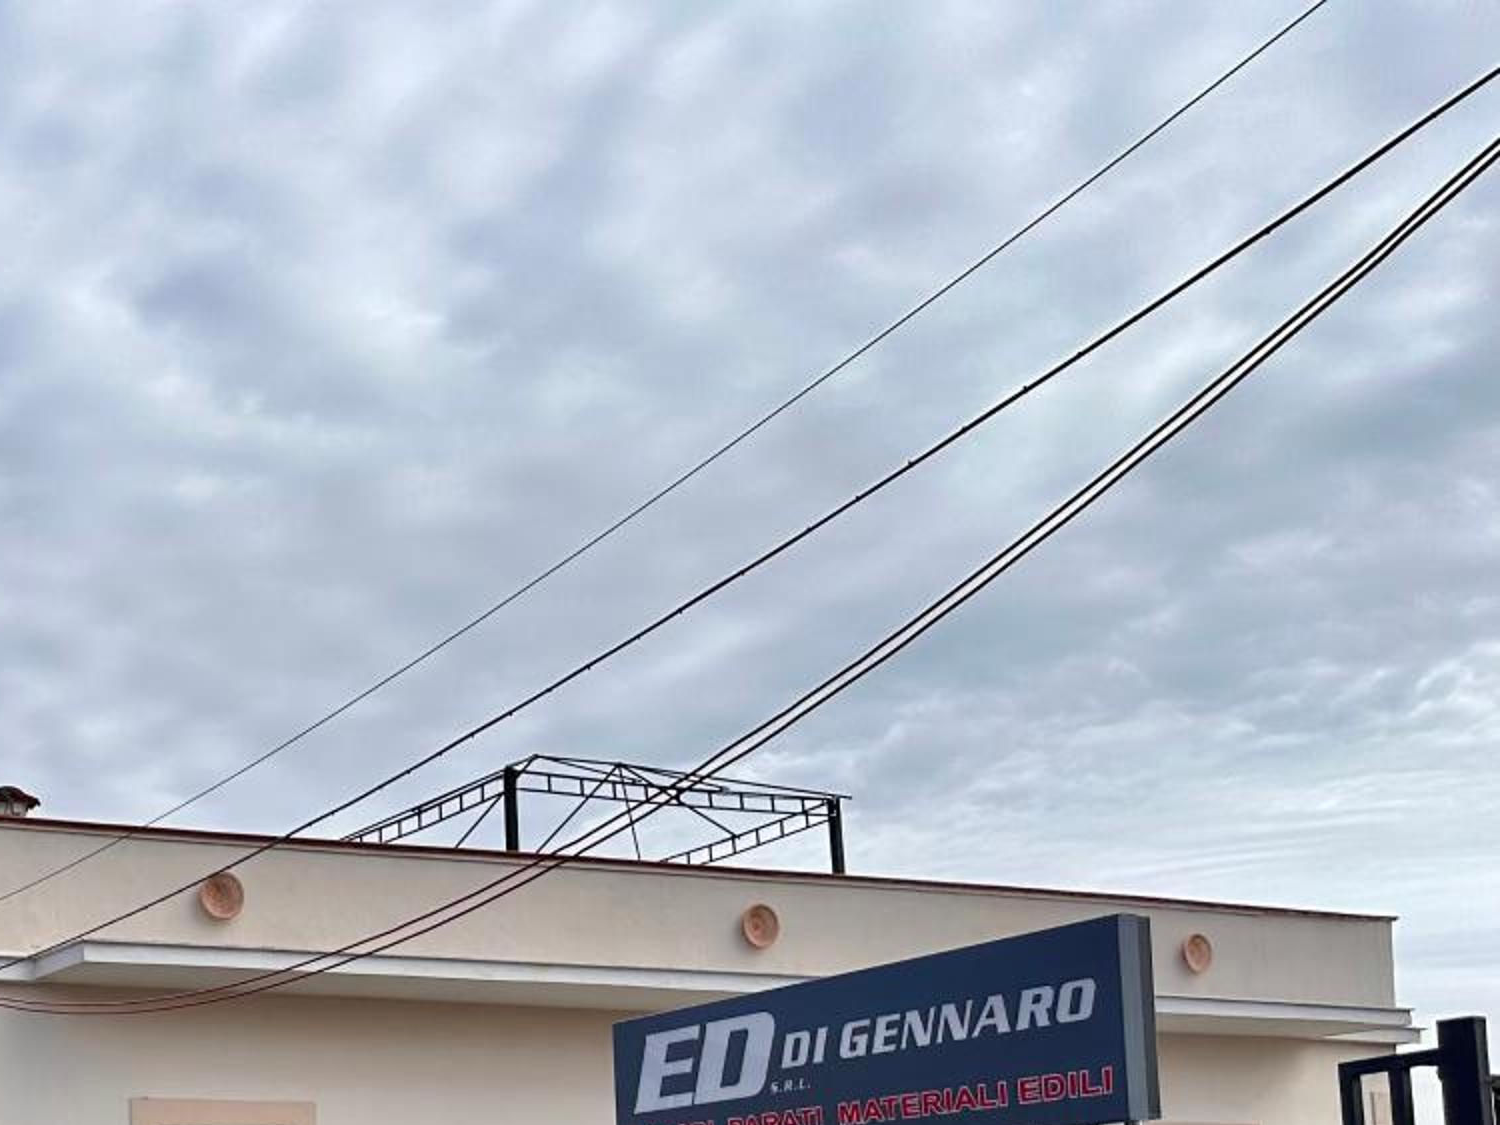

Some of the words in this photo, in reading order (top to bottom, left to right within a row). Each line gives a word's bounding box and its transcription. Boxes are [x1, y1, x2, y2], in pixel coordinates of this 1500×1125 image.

[634, 1011, 775, 1115] ED
[781, 1026, 828, 1069] DI
[838, 977, 1097, 1059] GENNARO
[771, 1079, 811, 1093] S.R.L.
[1017, 1064, 1114, 1105] EDILI
